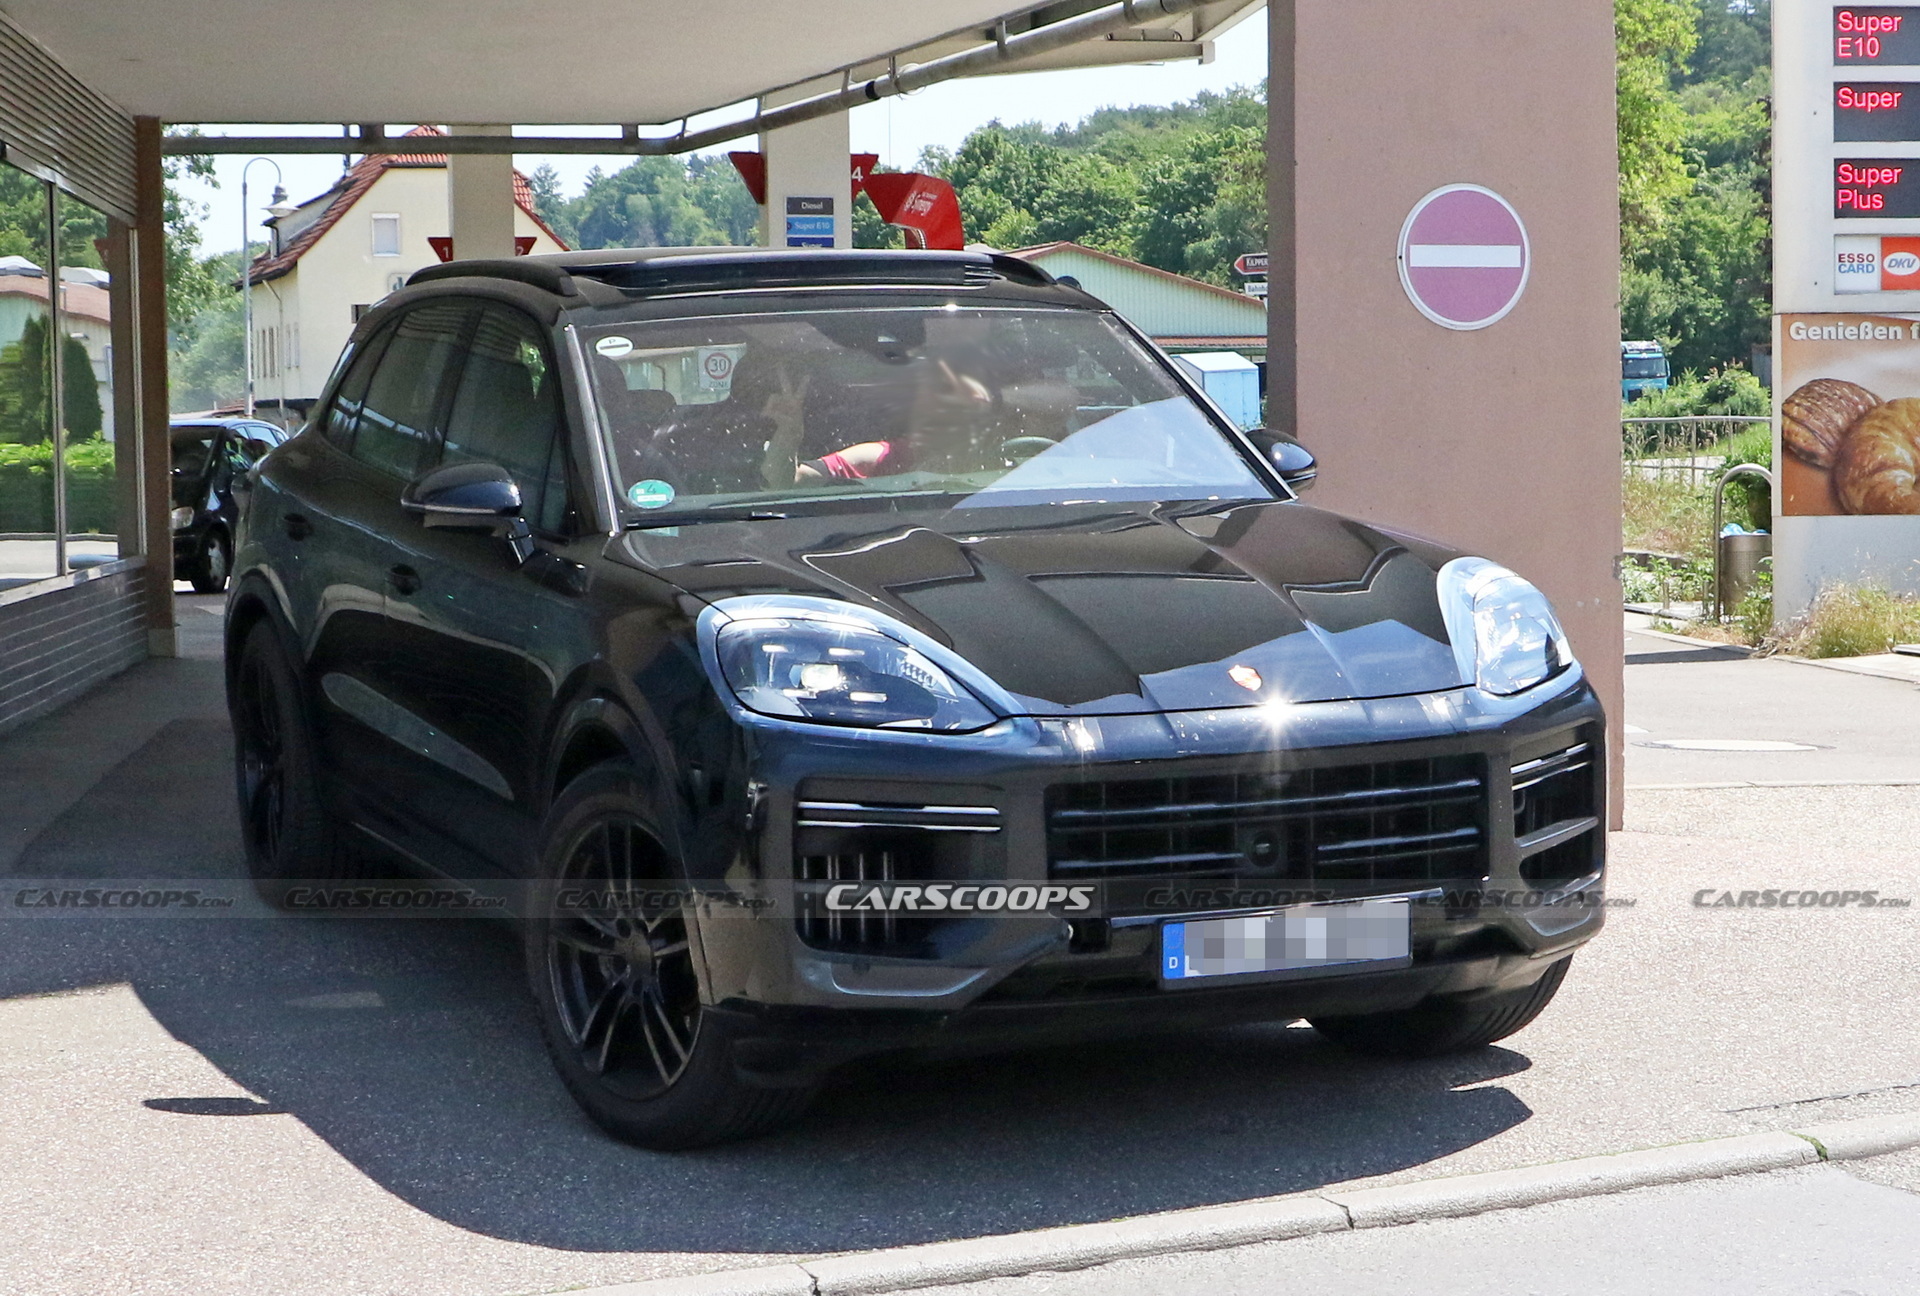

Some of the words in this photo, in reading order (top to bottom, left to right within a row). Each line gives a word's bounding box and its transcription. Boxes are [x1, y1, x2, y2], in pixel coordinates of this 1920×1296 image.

[1837, 11, 1902, 36] Super
[1837, 37, 1880, 58] E10
[1837, 87, 1902, 112] Super
[851, 166, 864, 182] 4
[1837, 163, 1902, 188] Super
[1837, 189, 1884, 210] Plus
[794, 221, 815, 232] Super
[816, 221, 830, 230] E10
[442, 246, 449, 259] 1
[516, 246, 524, 256] 2
[1837, 253, 1875, 263] ESSO
[1837, 263, 1875, 274] CARD
[1887, 257, 1917, 269] DKV
[1789, 321, 1903, 341] Genießen
[710, 358, 727, 373] 30
[646, 483, 656, 494] 4
[1168, 957, 1178, 969] D
